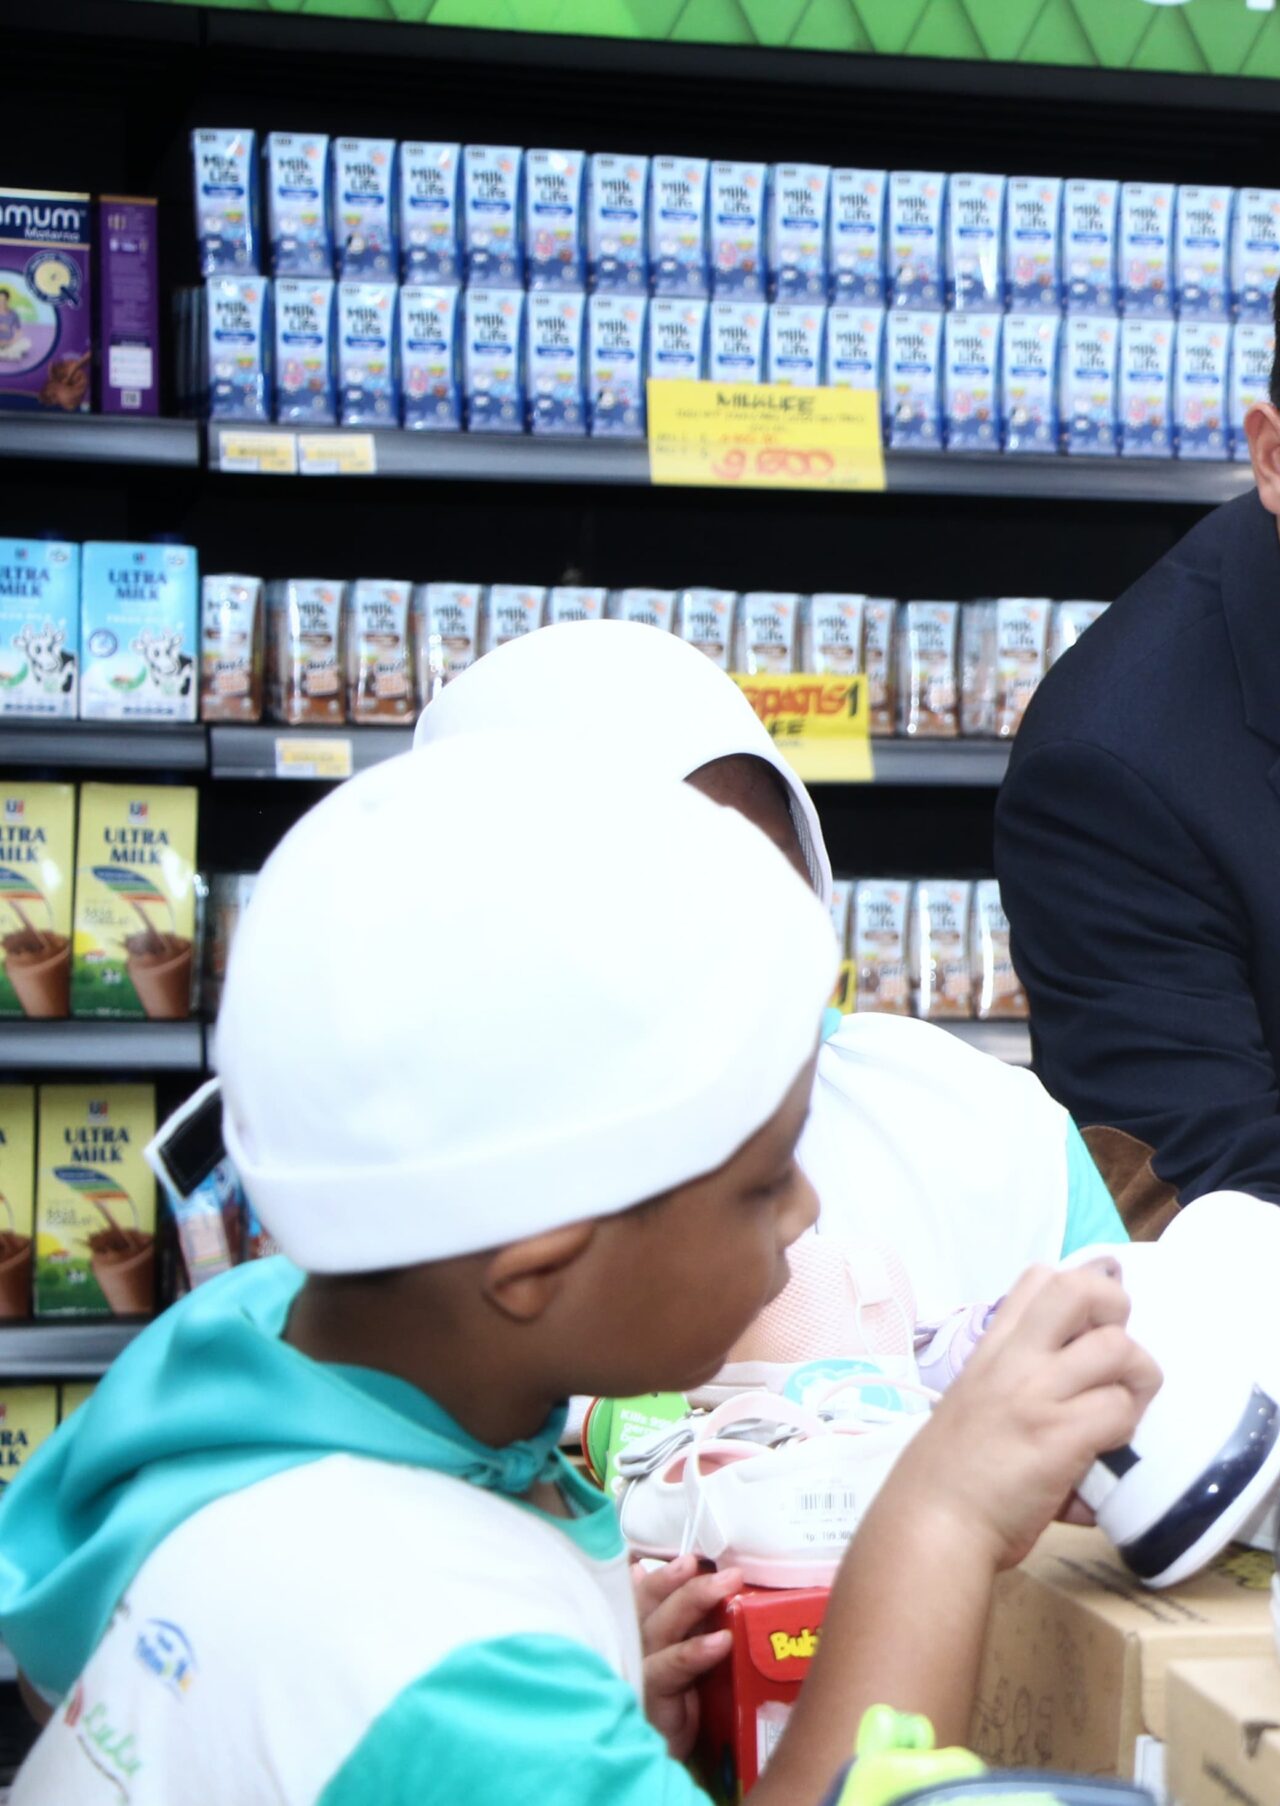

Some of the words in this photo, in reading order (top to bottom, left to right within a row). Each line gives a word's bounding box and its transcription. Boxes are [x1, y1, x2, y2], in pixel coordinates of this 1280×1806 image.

[203, 153, 237, 168] Milk
[279, 157, 310, 171] Milk
[345, 163, 376, 177] Milk
[411, 167, 442, 182] Milk
[472, 170, 504, 185] Milk
[535, 175, 566, 189] Milk
[601, 179, 630, 193] Milk
[661, 181, 691, 195] Milk
[719, 187, 748, 200] Milk
[784, 189, 812, 202] Milk
[839, 194, 869, 207] Milk
[898, 196, 927, 210] Milk
[958, 199, 987, 212] Milk
[1016, 201, 1044, 214] Milk
[1073, 203, 1101, 216] Milk
[0, 204, 80, 231] mum
[1130, 207, 1158, 220] Milk
[1186, 208, 1214, 222] Milk
[1248, 213, 1274, 225] Milk
[217, 302, 249, 316] Milk
[284, 304, 316, 318] Milk
[347, 307, 378, 321] Milk
[409, 310, 440, 324] Milk
[475, 313, 505, 327] Milk
[537, 316, 567, 330] Milk
[598, 319, 628, 333] Milk
[659, 322, 689, 336] Milk
[719, 326, 749, 339] Milk
[778, 328, 807, 342] Milk
[837, 331, 866, 344] Milk
[896, 335, 925, 348] Milk
[954, 337, 983, 350] Milk
[1012, 338, 1041, 352] Milk
[1076, 342, 1102, 355] Milk
[1130, 343, 1158, 356] Milk
[1186, 345, 1213, 358] Milk
[108, 570, 167, 585] ULTRA
[0, 826, 46, 844] LTRA
[104, 828, 169, 845] ULTRA
[0, 847, 38, 863] ILK
[110, 849, 161, 865] MILK
[64, 1127, 129, 1144] ULTRA
[71, 1147, 122, 1163] MILK
